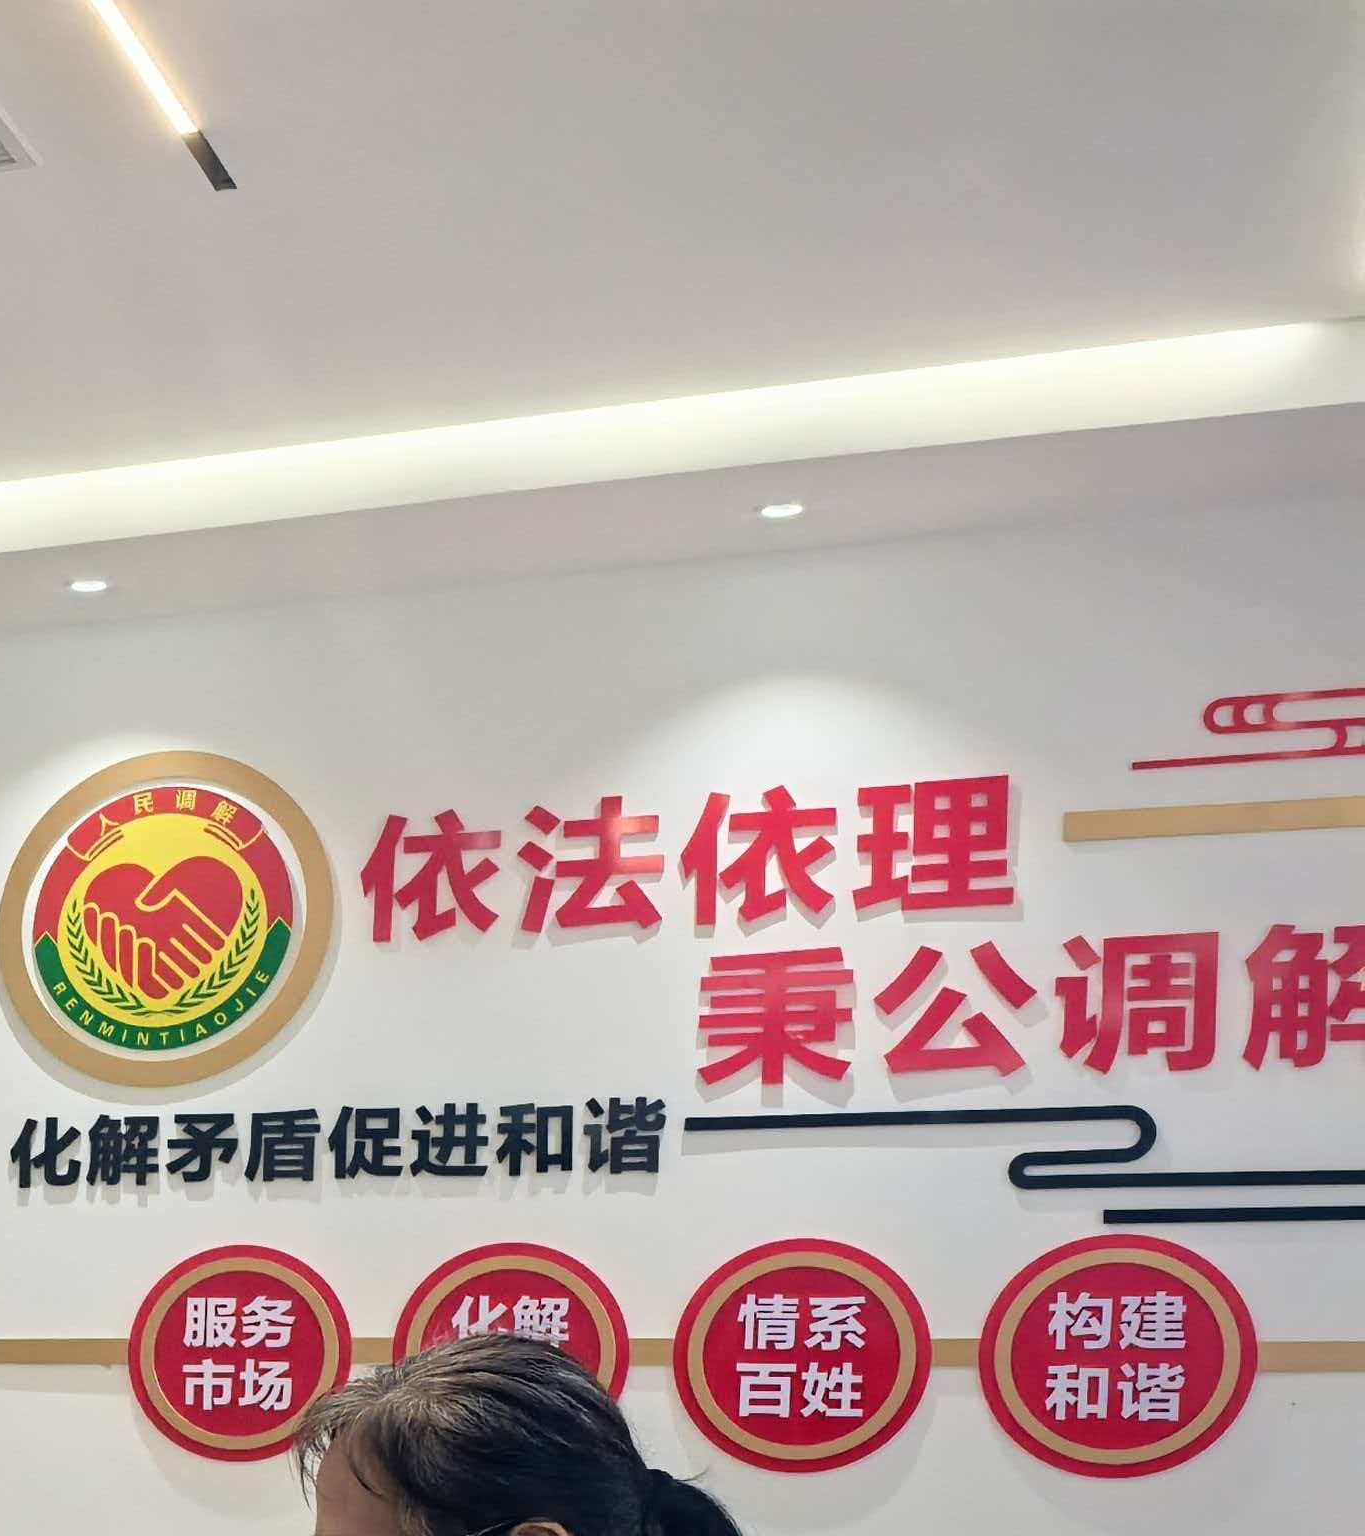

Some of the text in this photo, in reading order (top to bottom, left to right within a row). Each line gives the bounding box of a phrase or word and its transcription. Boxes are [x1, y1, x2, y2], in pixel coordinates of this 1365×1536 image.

[99, 790, 238, 837] 人民调解
[361, 775, 1014, 942] 依法依理
[53, 970, 269, 1045] RENMINTIAOJIE
[697, 924, 1365, 1084] 秉公调解
[10, 1097, 666, 1189] 化解矛盾促进和谐
[183, 1296, 296, 1349] 服务
[451, 1295, 569, 1348] 化解
[737, 1295, 867, 1352] 情系
[1048, 1291, 1188, 1351] 构建
[183, 1359, 293, 1414] 市场
[736, 1361, 864, 1419] 百姓
[1046, 1362, 1185, 1422] 和谐
